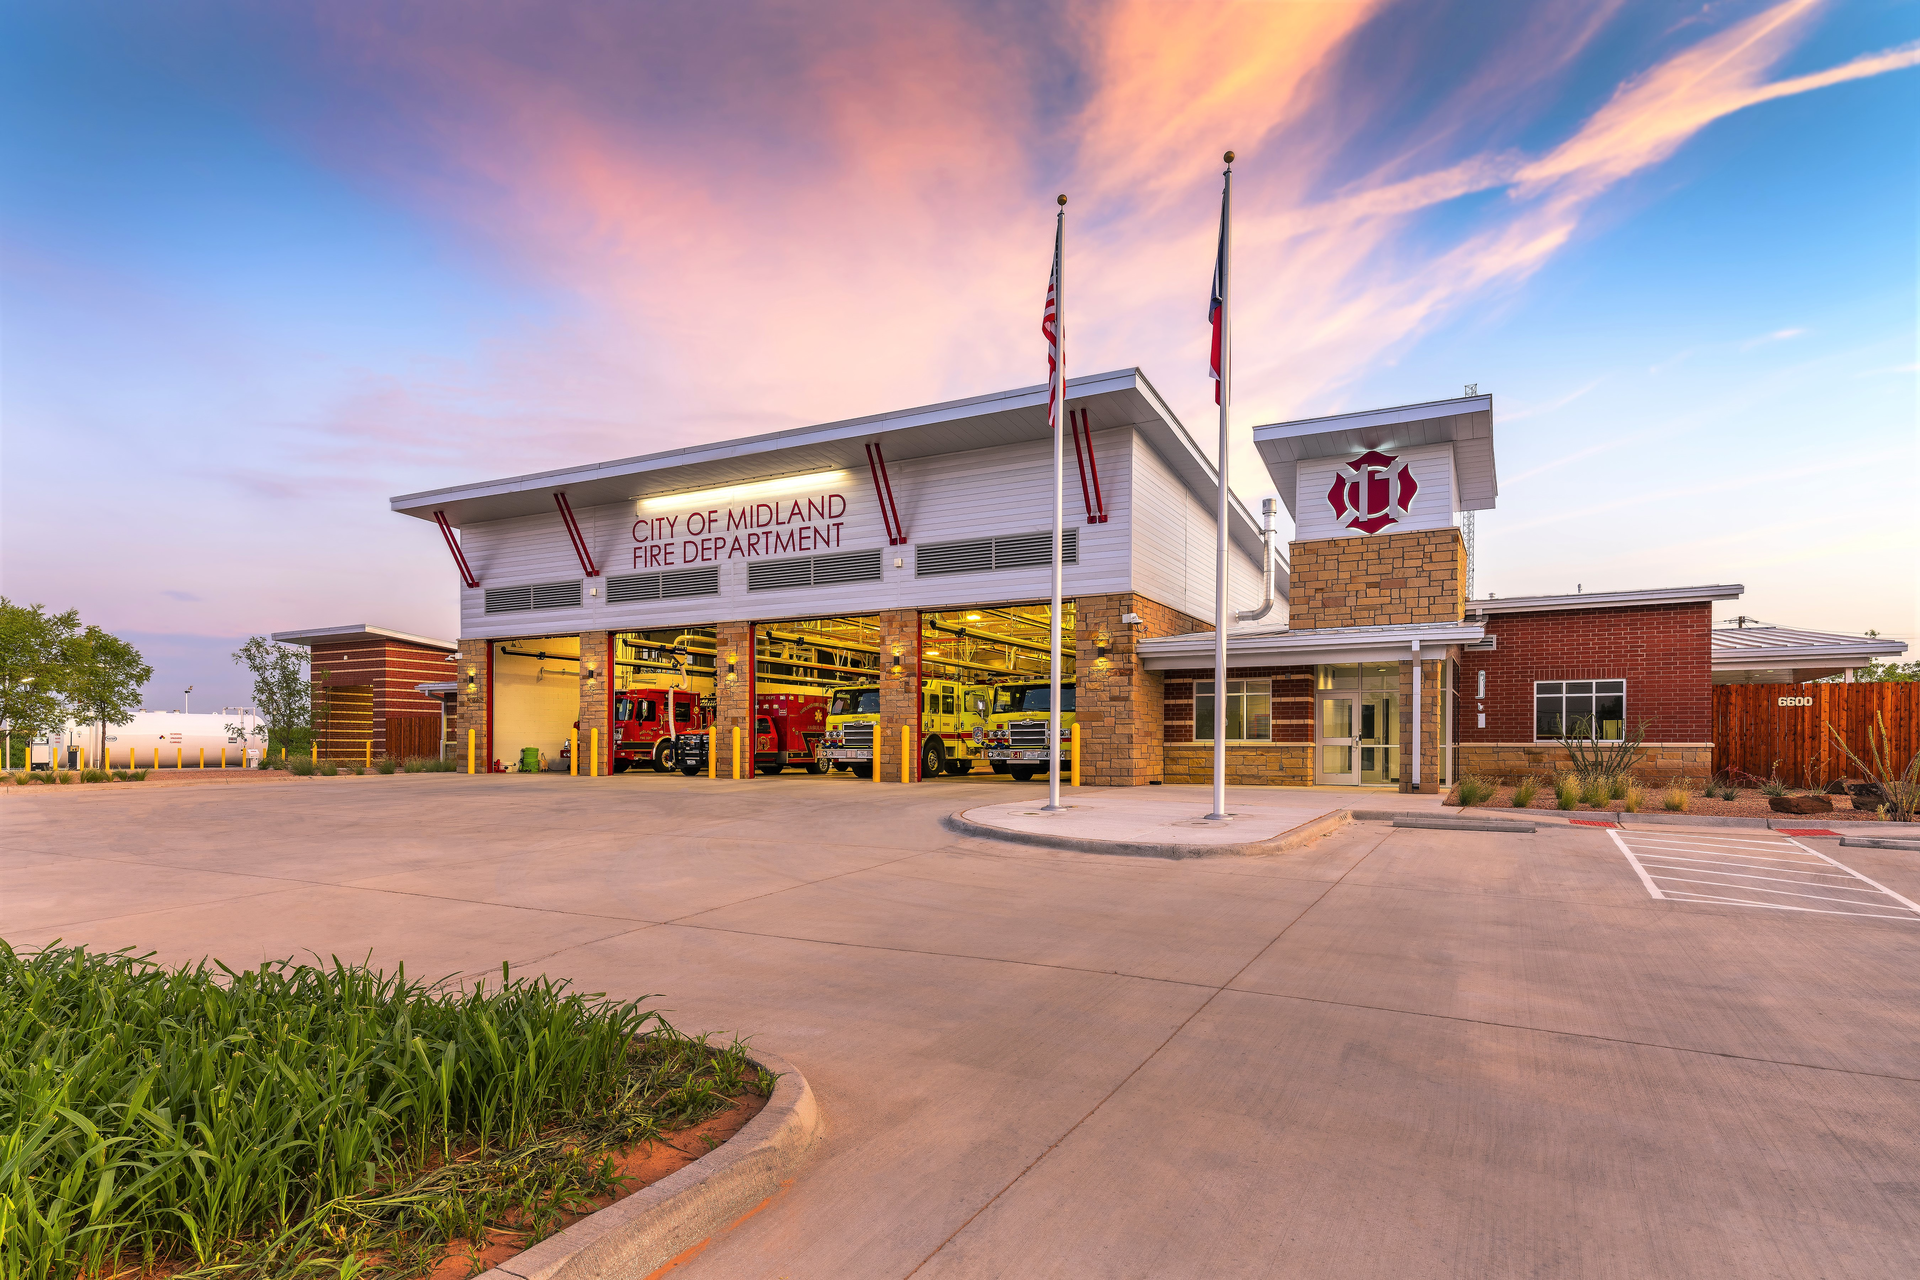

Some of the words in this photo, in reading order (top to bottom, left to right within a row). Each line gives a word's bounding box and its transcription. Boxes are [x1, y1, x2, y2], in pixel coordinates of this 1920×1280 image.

[1344, 460, 1399, 522] 11
[632, 515, 678, 543] CITY
[686, 509, 718, 536] OF
[726, 493, 847, 532] MIDLAND
[633, 542, 675, 569] FIRE
[683, 522, 844, 564] DEPARTMENT
[1777, 696, 1813, 707] 6600
